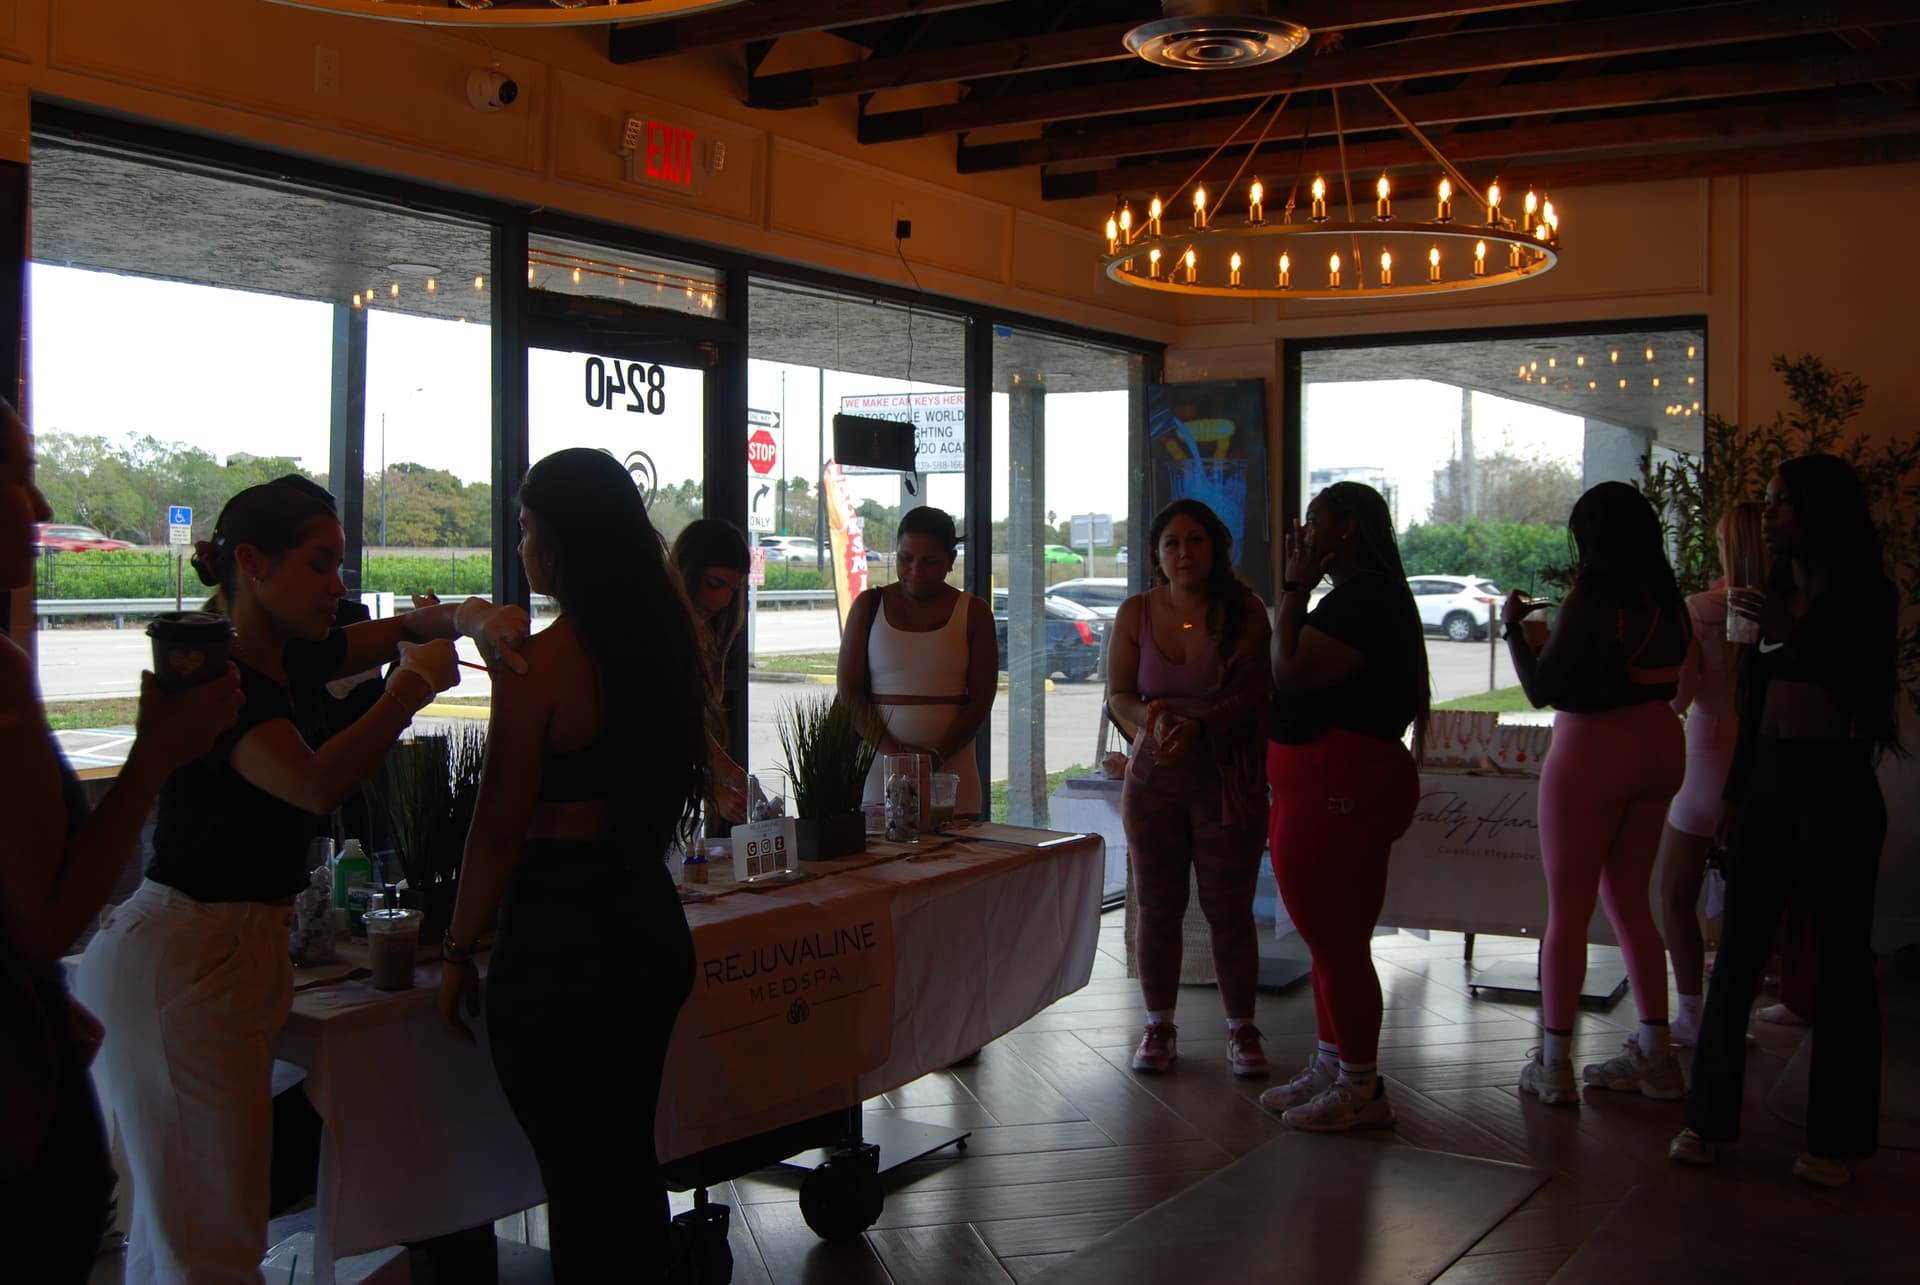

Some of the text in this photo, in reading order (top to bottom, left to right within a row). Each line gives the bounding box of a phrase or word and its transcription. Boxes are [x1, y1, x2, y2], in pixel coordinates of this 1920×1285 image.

[647, 120, 695, 186] EXIT
[845, 399, 860, 408] WE
[862, 398, 889, 407] MAKE
[915, 396, 940, 406] KEYS
[925, 409, 964, 422] WORLD
[748, 442, 776, 462] STOP
[750, 515, 771, 528] ONLY
[703, 922, 877, 988] REJUVALINE
[750, 967, 841, 1001] MEDSPA
